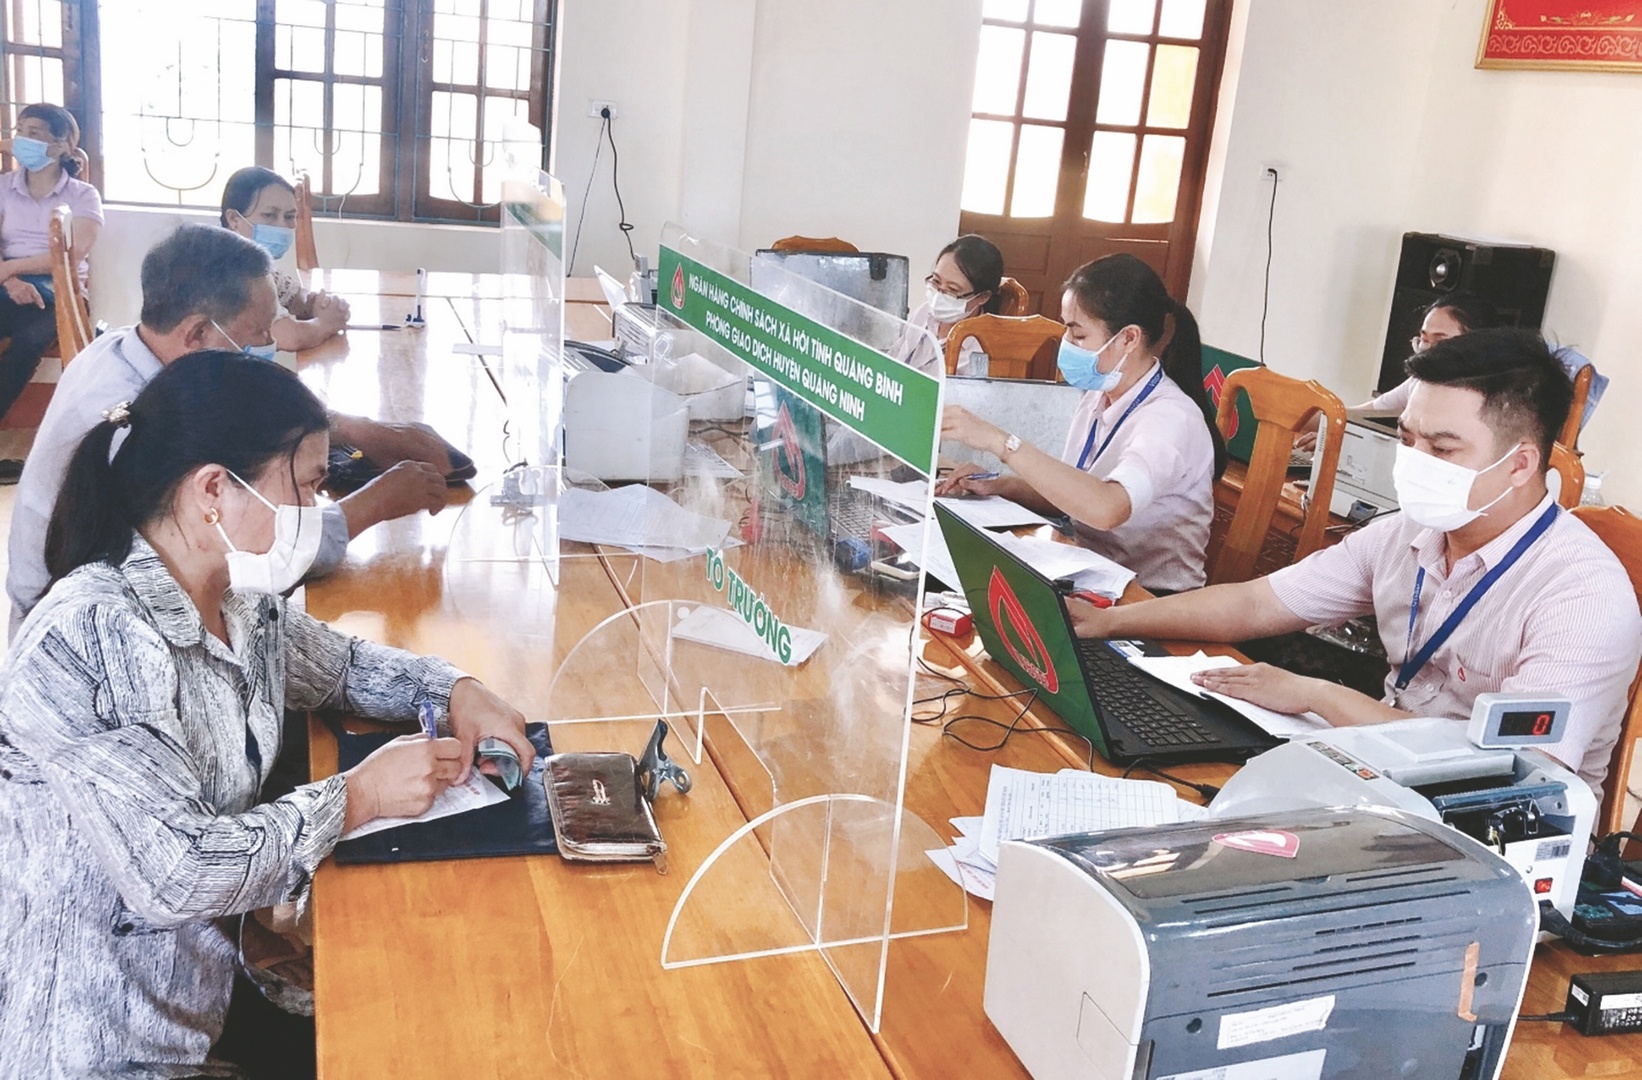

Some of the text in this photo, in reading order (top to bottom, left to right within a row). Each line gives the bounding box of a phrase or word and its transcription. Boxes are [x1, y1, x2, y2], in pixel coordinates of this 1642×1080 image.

[688, 272, 708, 298] NGÂN
[708, 283, 729, 309] HÀNG
[730, 296, 754, 324] CHÍNH
[754, 308, 777, 337] SÁCH
[778, 320, 791, 345] XÃ
[833, 351, 874, 389] QUẢNG
[875, 371, 904, 406] BÌNH
[705, 310, 865, 421] PHÒNG GIAO DỊCH HUYỆN QUẢNG NINH
[1532, 713, 1550, 736] 0
